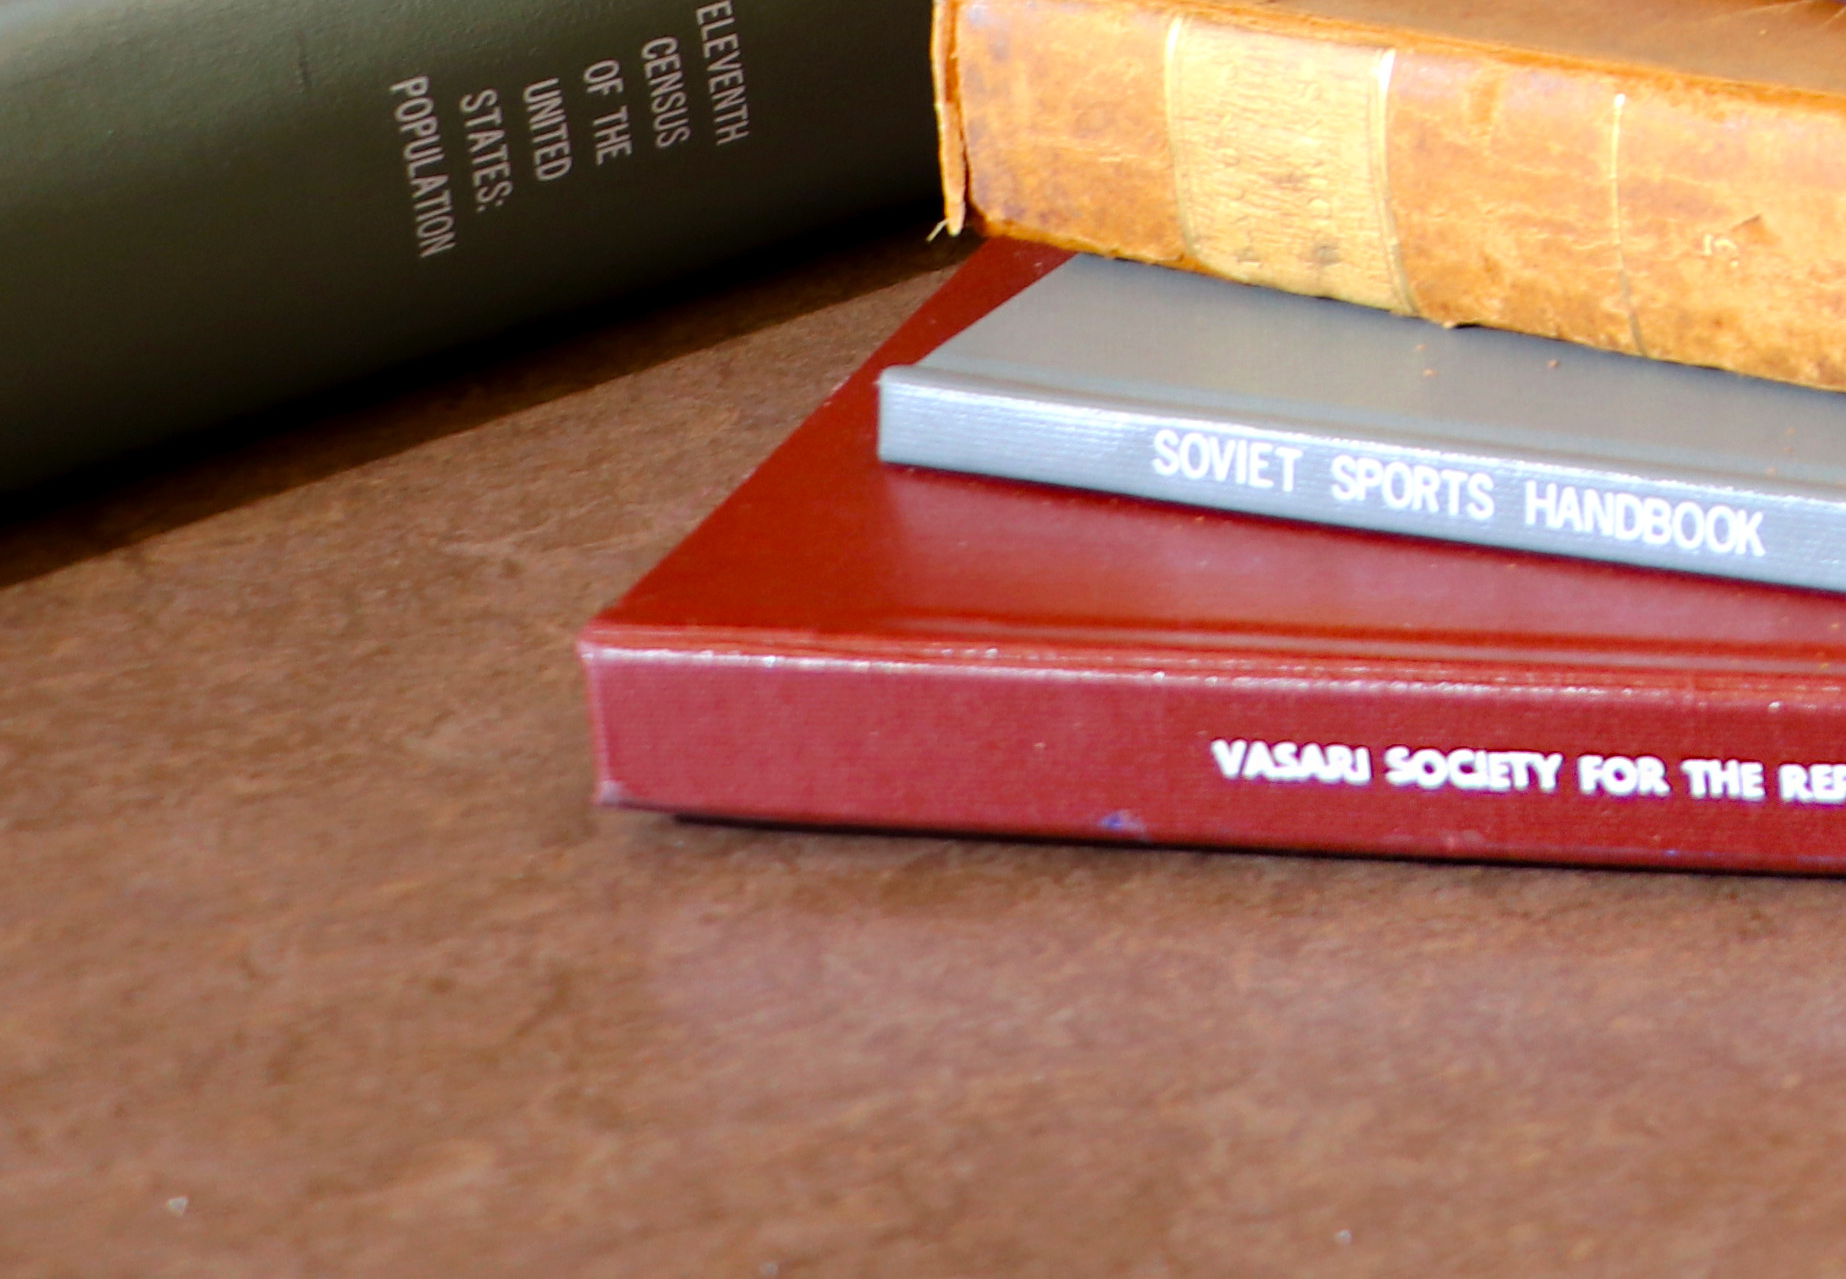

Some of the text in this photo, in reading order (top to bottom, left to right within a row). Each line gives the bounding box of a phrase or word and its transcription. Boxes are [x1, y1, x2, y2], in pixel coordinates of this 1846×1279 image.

[522, 79, 573, 183] UNITED
[583, 59, 634, 165] OF THE
[640, 36, 690, 149] CENSUS
[695, 0, 749, 145] ELEVENTH
[389, 75, 456, 258] POPULATION
[459, 89, 514, 215] STATES:
[1151, 429, 1766, 557] SOVIET SPORTS HANDBOOK
[1211, 737, 1371, 785] VASARI
[1385, 746, 1564, 793] SOCIETY
[1578, 754, 1672, 799] FOR
[1681, 758, 1764, 802] THE
